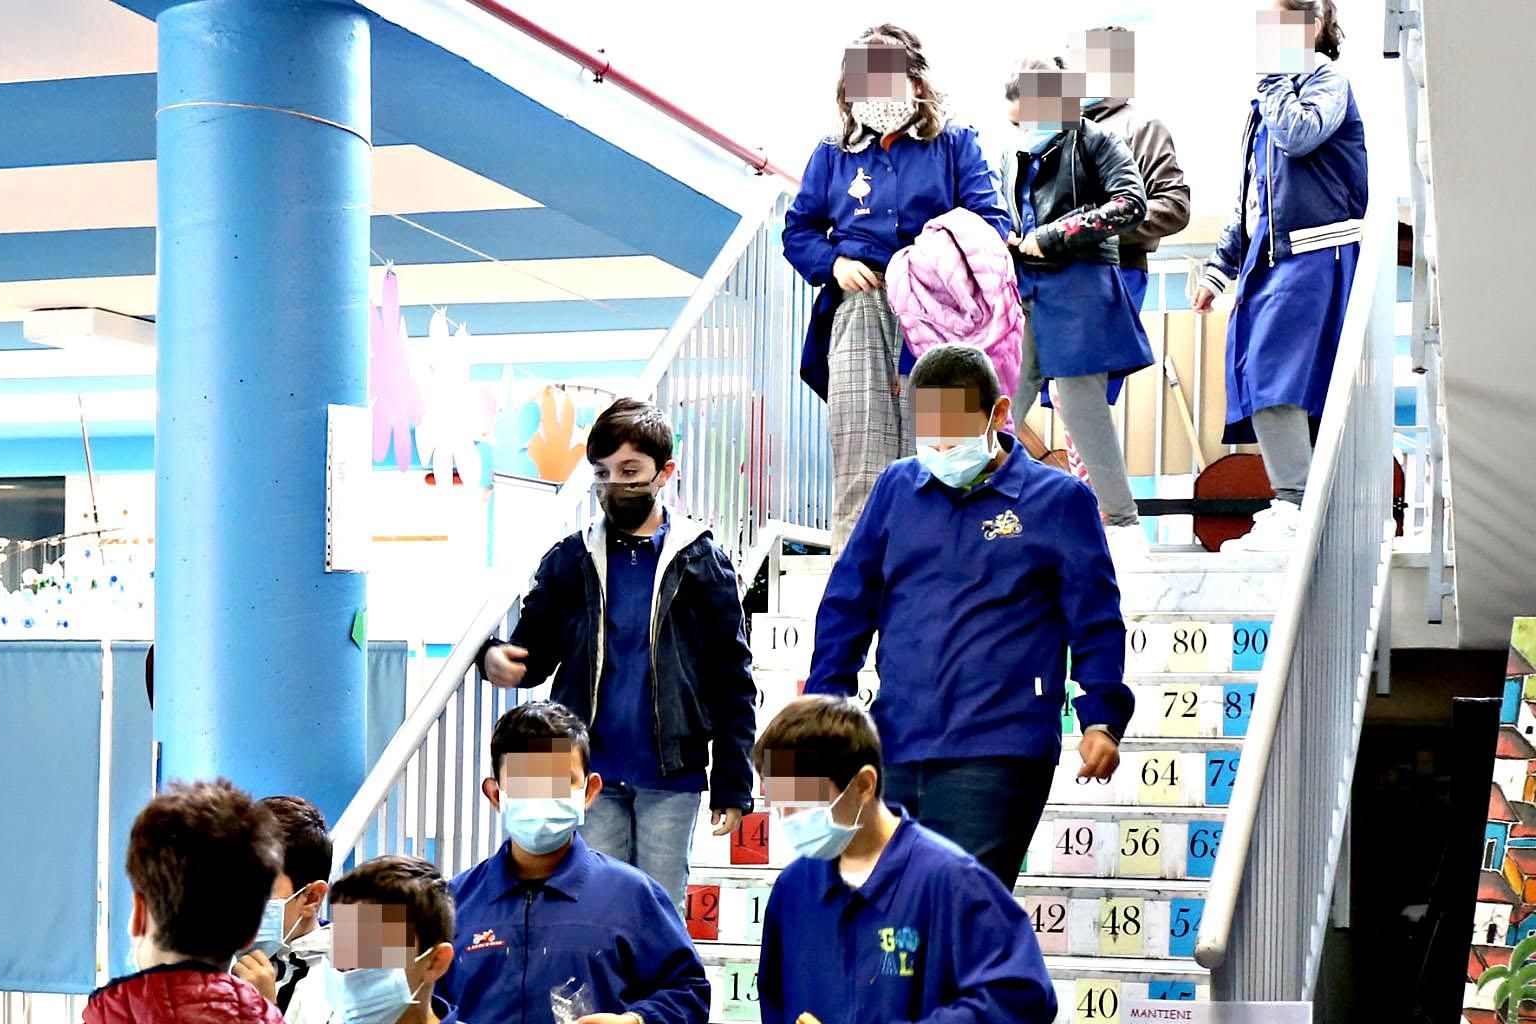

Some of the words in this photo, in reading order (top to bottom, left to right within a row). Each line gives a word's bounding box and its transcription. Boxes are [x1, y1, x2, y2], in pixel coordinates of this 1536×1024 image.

[772, 626, 799, 650] 10
[1131, 629, 1147, 654] 0
[1172, 627, 1208, 655] 80
[1232, 627, 1269, 656] 90
[1162, 690, 1198, 719] 72
[1140, 758, 1179, 787] 64
[735, 819, 769, 848] 14
[1055, 826, 1094, 857] 49
[1120, 827, 1160, 858] 56
[686, 892, 718, 921] 12
[752, 896, 761, 924] 1
[1030, 903, 1066, 935] 42
[1100, 904, 1142, 936] 48
[1077, 987, 1119, 1019] 40
[1130, 1008, 1193, 1020] MANTIENI
